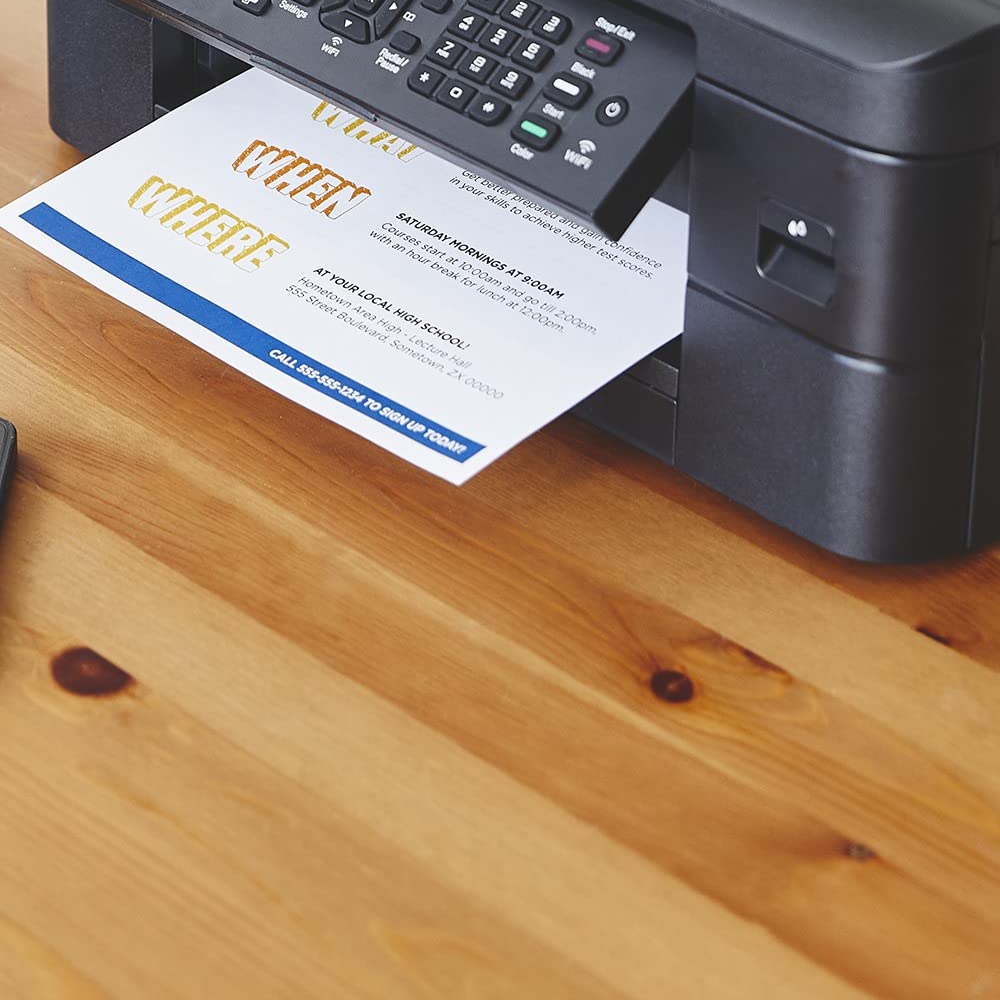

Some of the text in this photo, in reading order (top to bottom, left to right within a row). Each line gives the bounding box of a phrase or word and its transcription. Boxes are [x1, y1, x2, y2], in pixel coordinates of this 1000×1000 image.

[278, 0, 309, 20] Settings
[127, 175, 291, 274] WHERE
[231, 139, 372, 220] WHEN
[480, 177, 513, 199] better
[603, 236, 663, 270] confidence
[368, 229, 393, 246] with
[391, 241, 407, 253] an
[404, 248, 432, 266] hour
[429, 260, 460, 282] break
[459, 276, 478, 290] for
[475, 285, 507, 305] lunch
[505, 299, 519, 311] at
[381, 221, 421, 246] Courses
[420, 241, 447, 260] start
[446, 254, 459, 266] at
[458, 260, 503, 288] 10:00am
[501, 283, 525, 299] and
[523, 294, 540, 308] go
[395, 211, 566, 301] SATURDAY MORNINGS AT 9:00AM
[449, 176, 654, 280] in your skills to achieve higher test scores.
[285, 284, 308, 300] 555
[305, 294, 339, 316] Street
[336, 311, 388, 344] Boulevard,
[388, 338, 446, 374] Sometown,
[297, 275, 473, 370] Hometown Area High Lecture Hall
[312, 267, 472, 351] AT YOUR LOCAL HIGH SCHOOL!
[268, 348, 468, 456] CALL 555-555-1234 TO SIGN UP TODAY!
